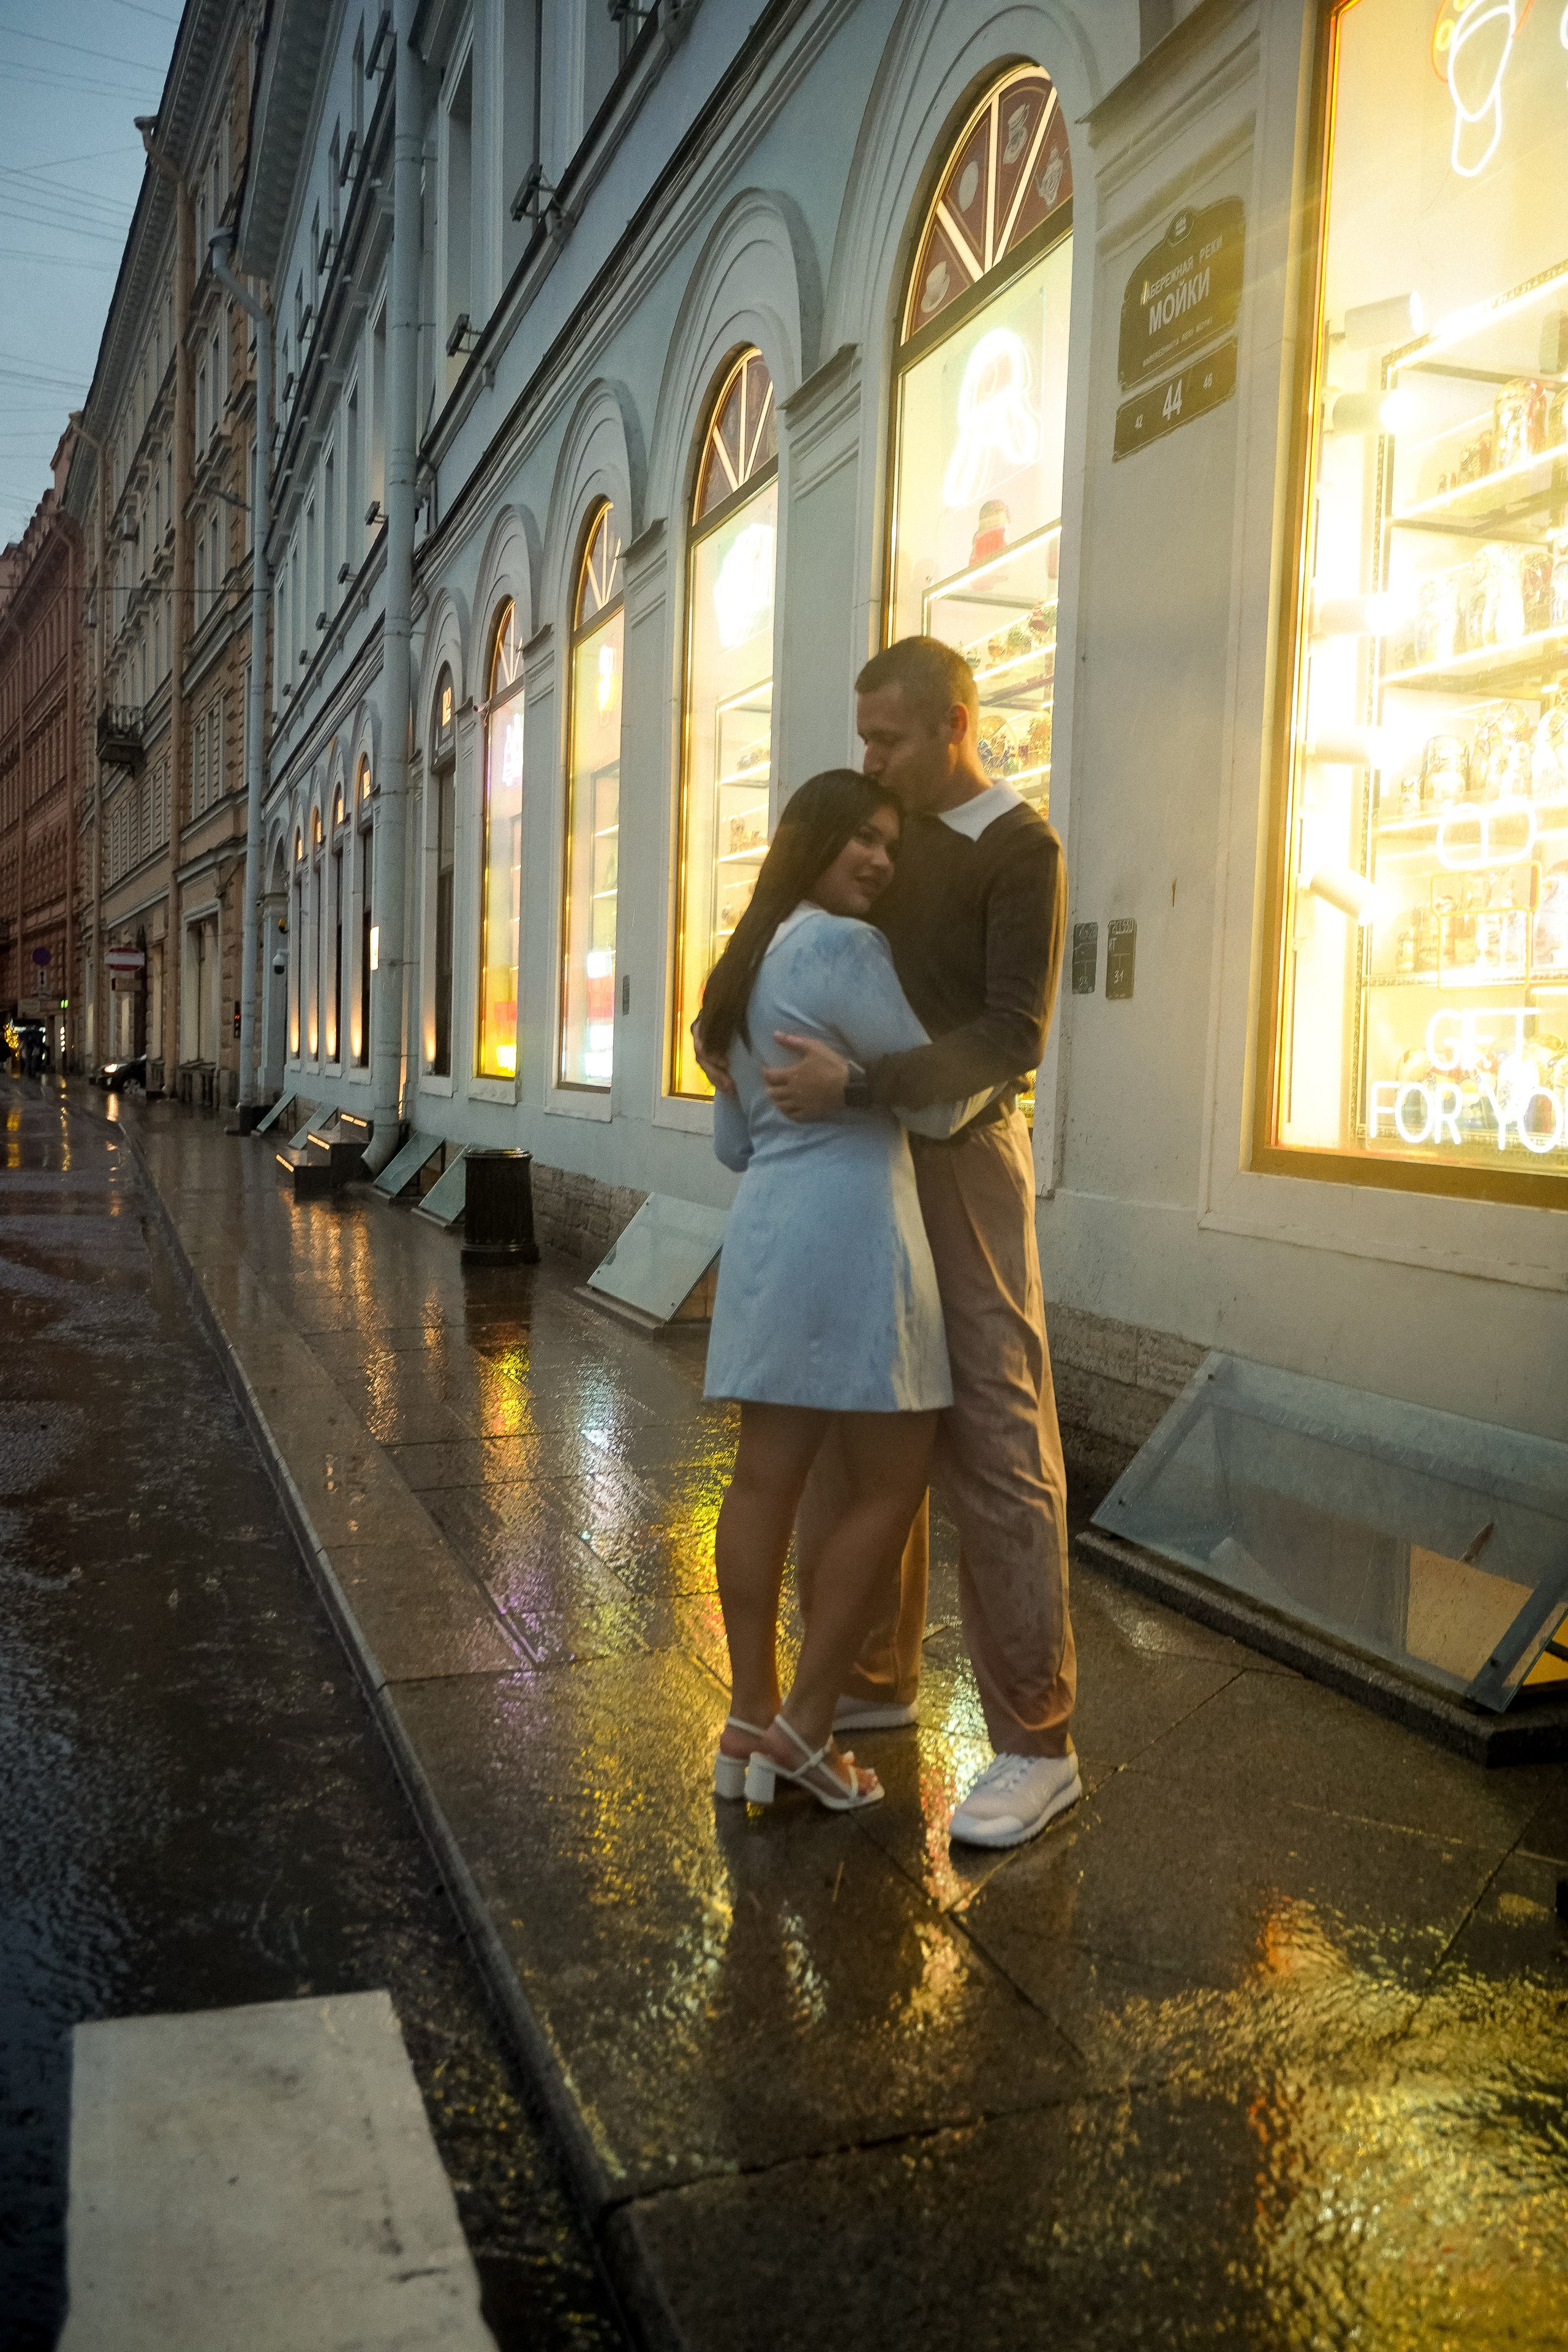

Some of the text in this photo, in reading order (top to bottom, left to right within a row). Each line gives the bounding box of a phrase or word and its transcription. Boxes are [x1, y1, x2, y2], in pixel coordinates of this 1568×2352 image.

[1140, 235, 1223, 305] НАБЕРЕЖНАЯ РЕКИ
[1148, 266, 1210, 336] МОЙКИ
[1162, 379, 1183, 421] 44
[1369, 1080, 1568, 1153] FOR YO
